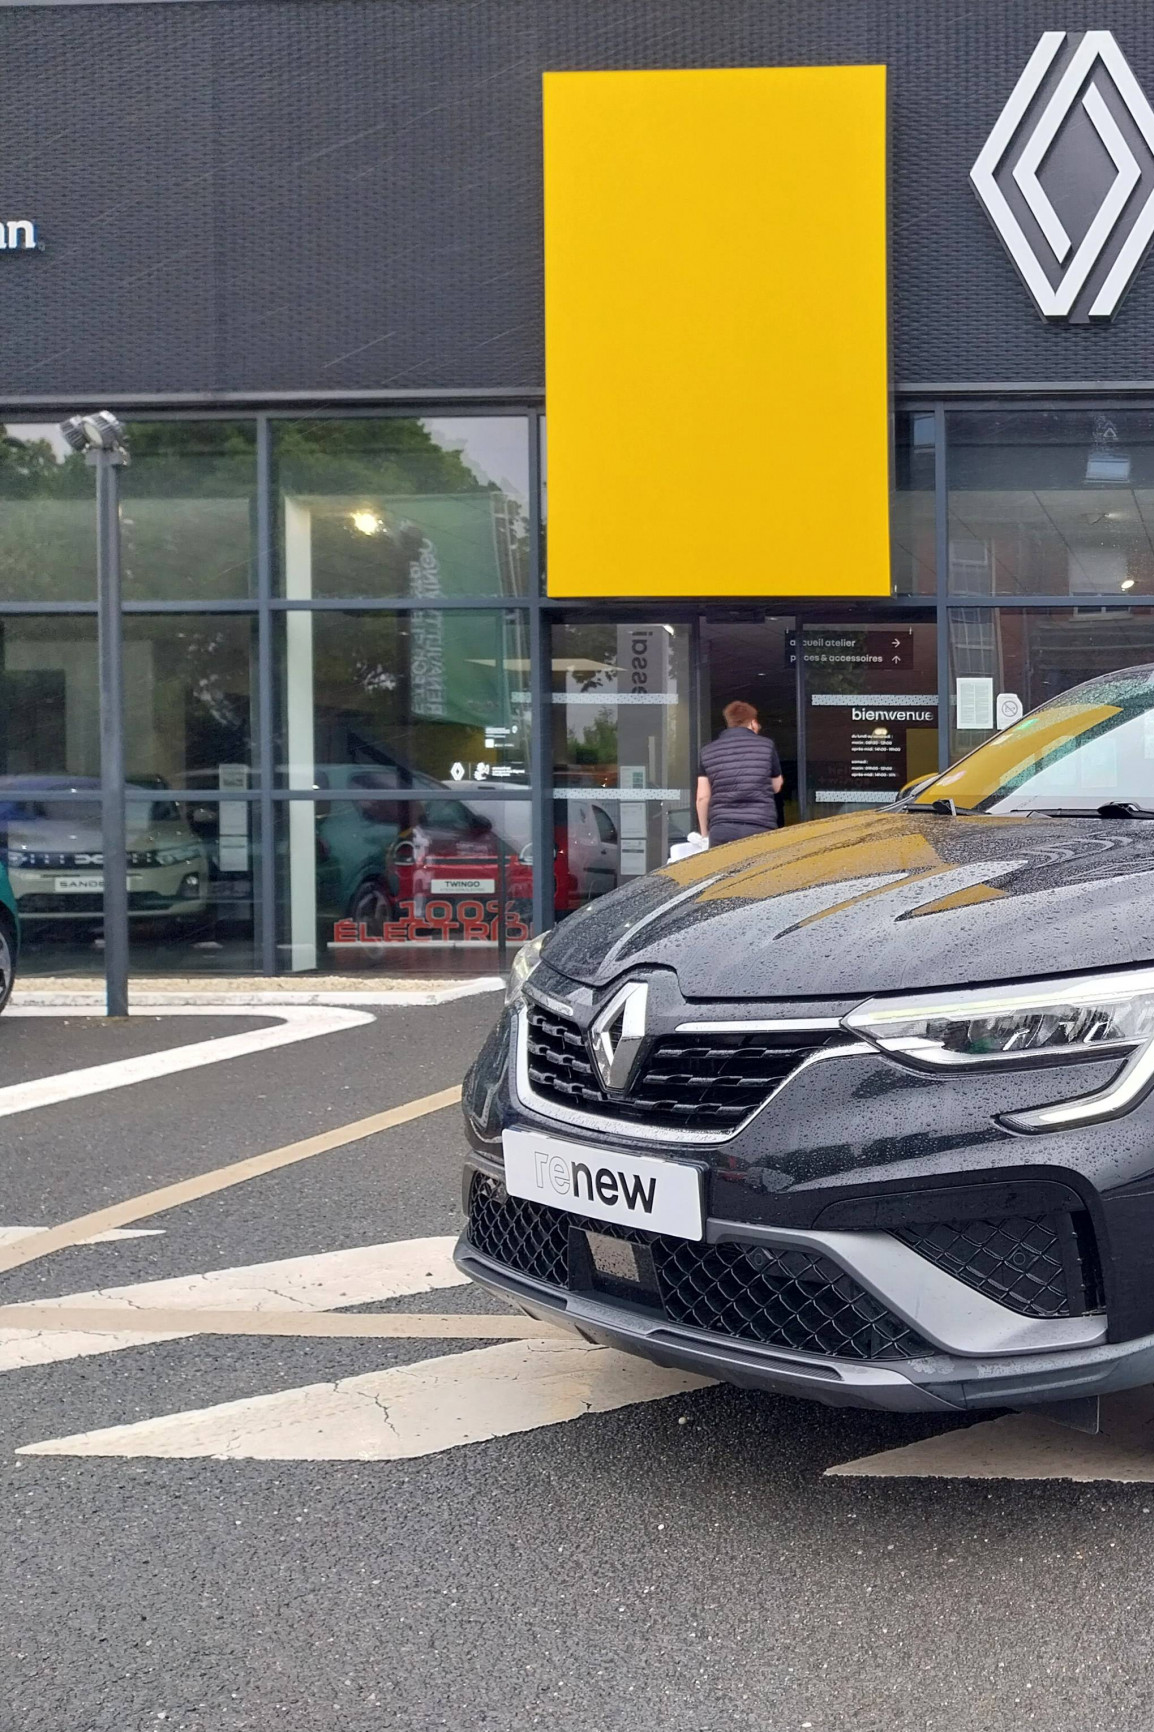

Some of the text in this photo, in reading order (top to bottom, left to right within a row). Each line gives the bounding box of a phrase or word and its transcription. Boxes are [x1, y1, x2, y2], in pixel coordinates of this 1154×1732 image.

[790, 638, 856, 647] acueil atelier
[790, 655, 819, 663] pces
[829, 654, 883, 663] accessoires
[852, 707, 934, 721] bienvenue
[400, 900, 520, 927] 100%
[534, 1151, 656, 1214] renew
